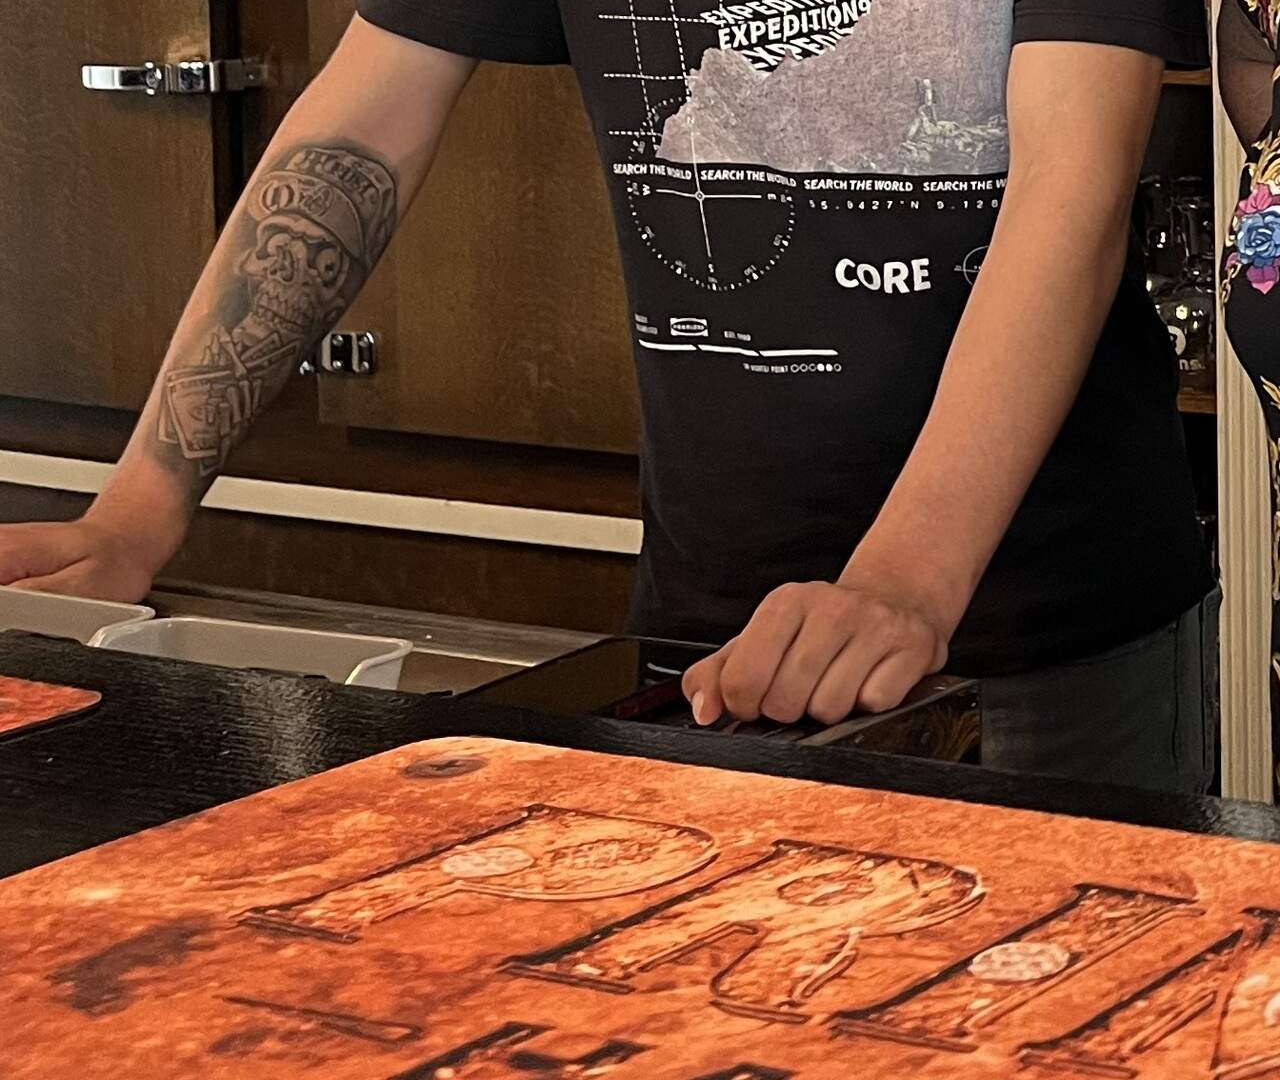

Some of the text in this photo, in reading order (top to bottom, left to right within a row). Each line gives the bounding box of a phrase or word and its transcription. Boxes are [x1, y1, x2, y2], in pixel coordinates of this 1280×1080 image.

[613, 163, 647, 175] SEARCH
[649, 164, 666, 176] THE
[700, 169, 744, 181] SEARCH
[745, 170, 766, 182] THE
[803, 178, 914, 192] SEARCH THE WORLD
[922, 180, 968, 192] SEARCH
[970, 179, 993, 191] THE
[835, 257, 932, 294] CORE
